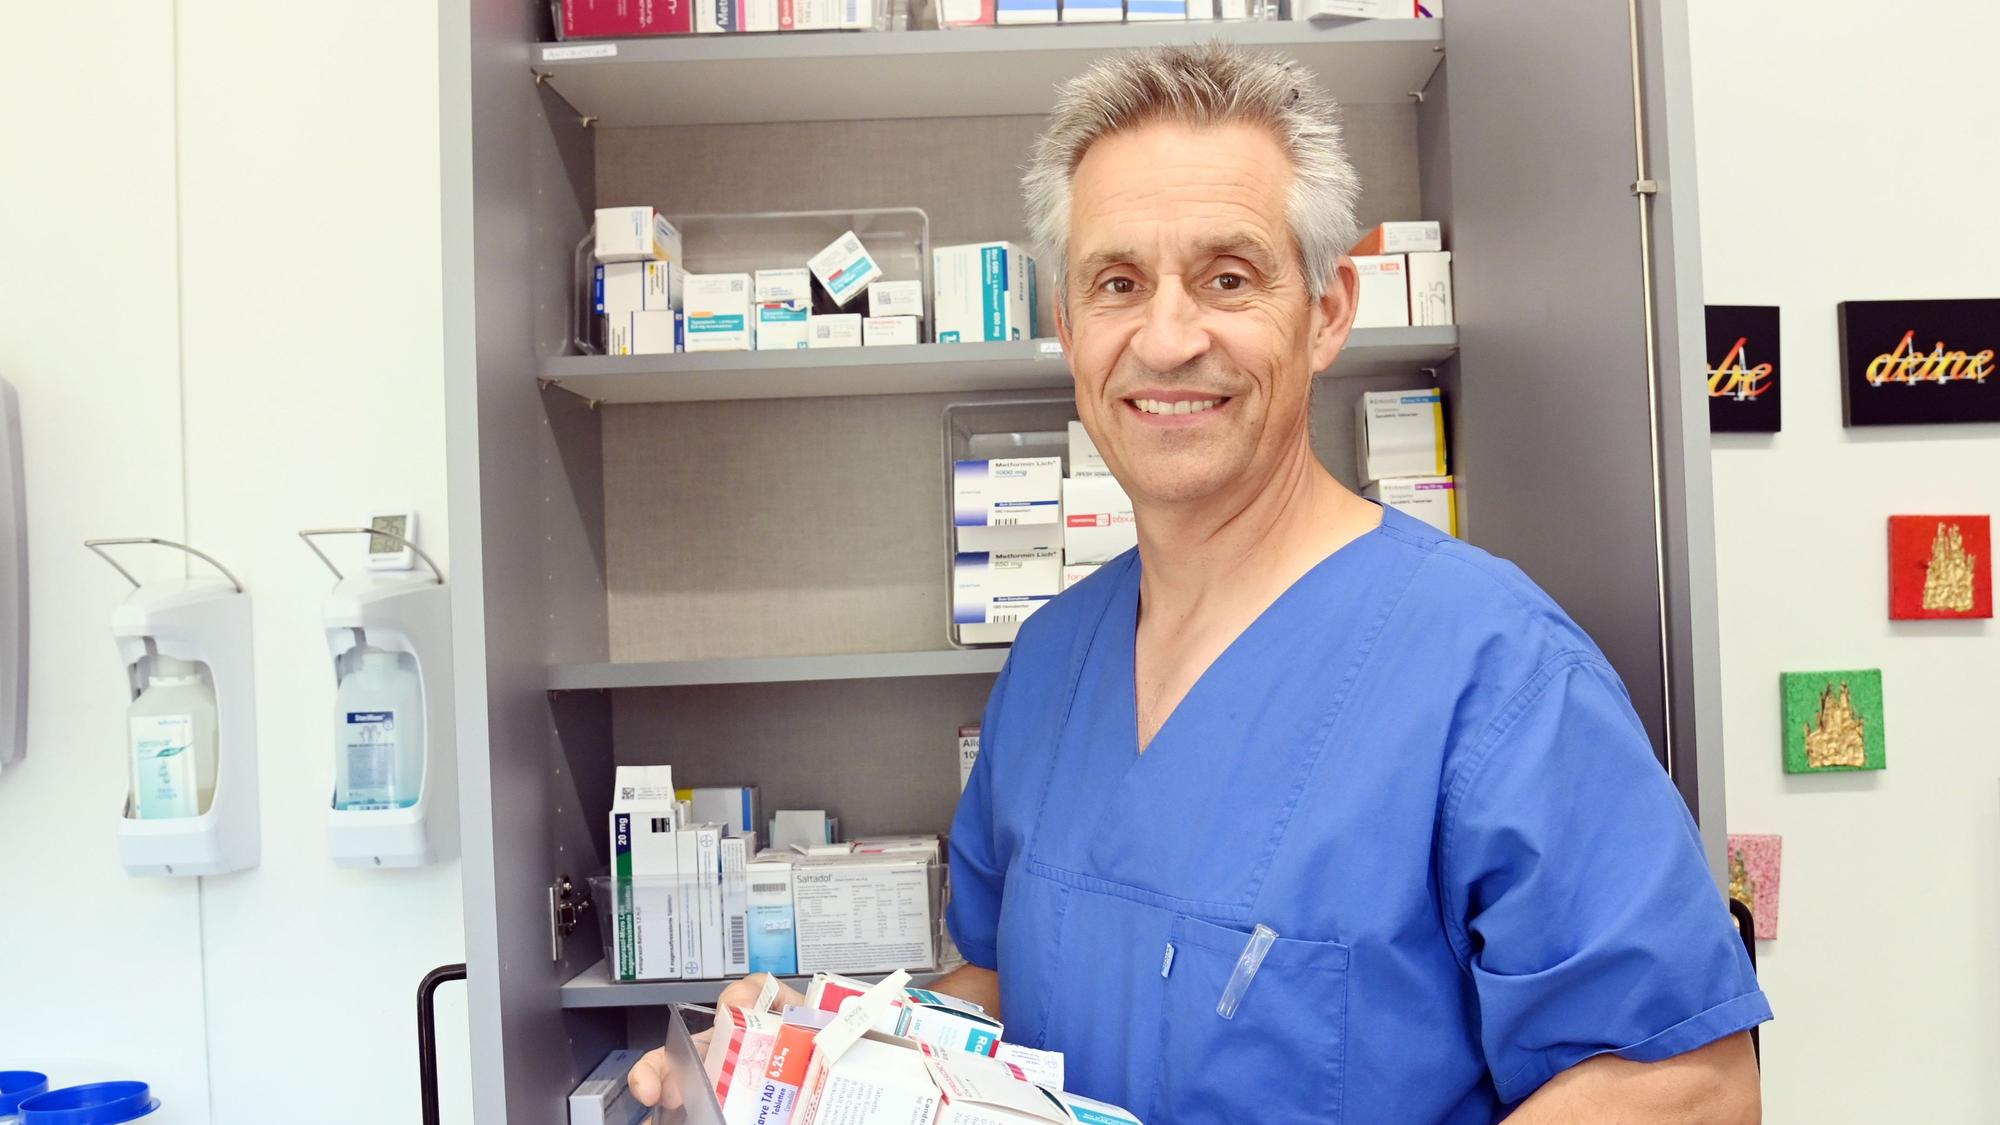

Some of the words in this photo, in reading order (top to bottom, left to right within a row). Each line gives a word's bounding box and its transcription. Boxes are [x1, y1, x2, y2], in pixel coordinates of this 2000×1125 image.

[717, 0, 730, 25] Met
[1429, 280, 1446, 305] 25
[1865, 330, 1996, 384] deine
[1014, 469, 1027, 477] mg
[618, 817, 629, 832] mg
[618, 833, 627, 846] 20
[973, 1035, 988, 1058] Ra
[769, 1054, 786, 1078] 6,25
[753, 1101, 769, 1125] arve
[771, 1087, 786, 1116] Tabletten
